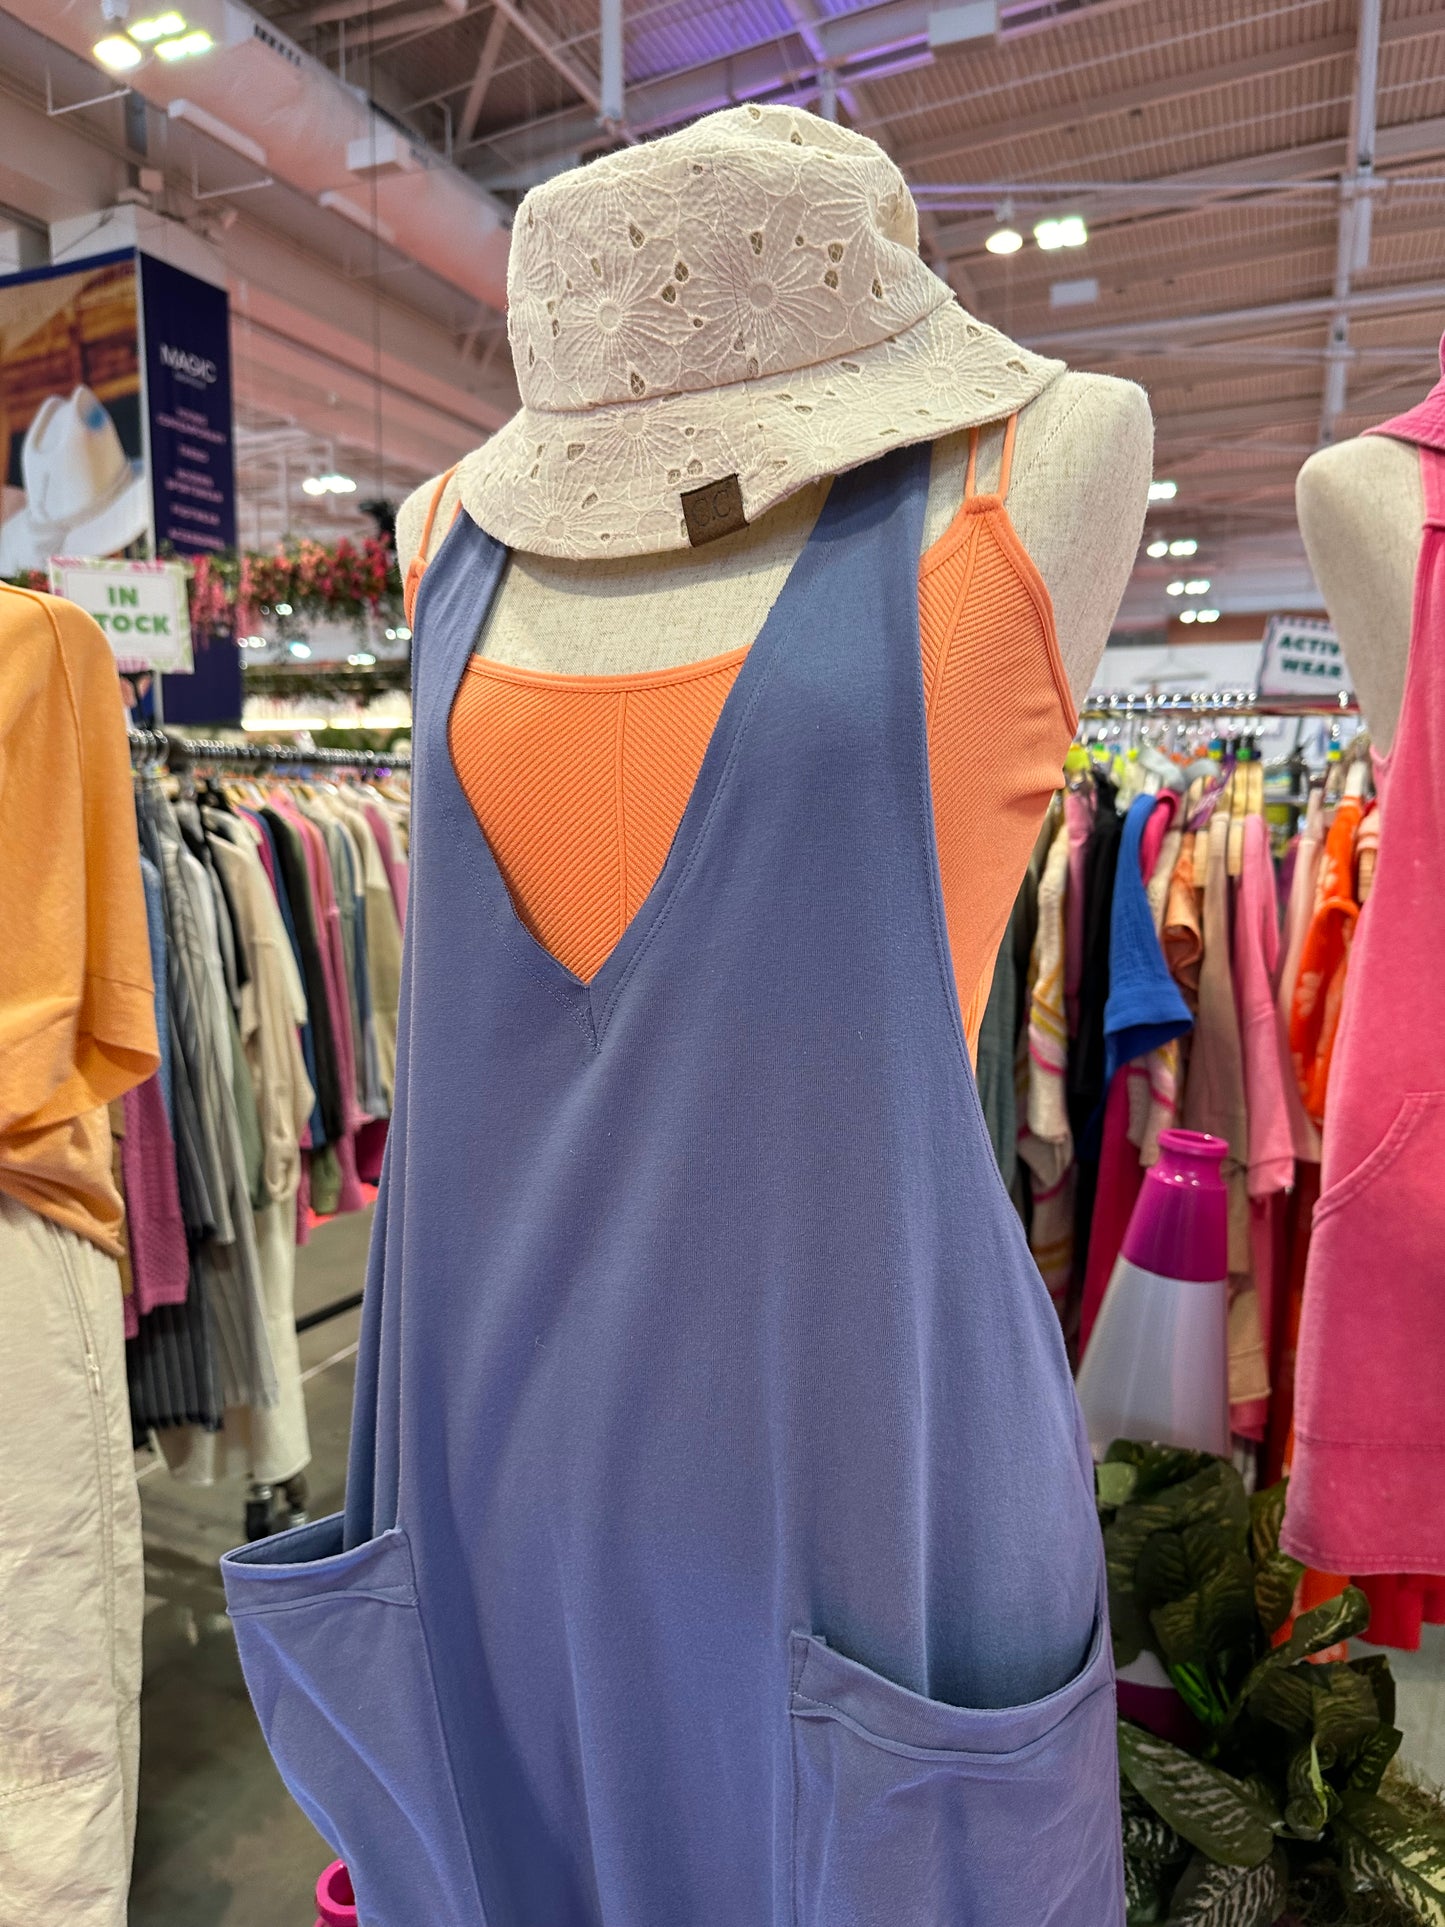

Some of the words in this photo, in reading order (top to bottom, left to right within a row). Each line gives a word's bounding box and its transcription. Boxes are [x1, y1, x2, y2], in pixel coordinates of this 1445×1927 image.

[160, 343, 217, 384] MAGIC
[107, 586, 138, 606] IN
[93, 613, 170, 635] TOCK
[1279, 635, 1340, 656] ACTIV
[1282, 659, 1342, 678] WEAR
